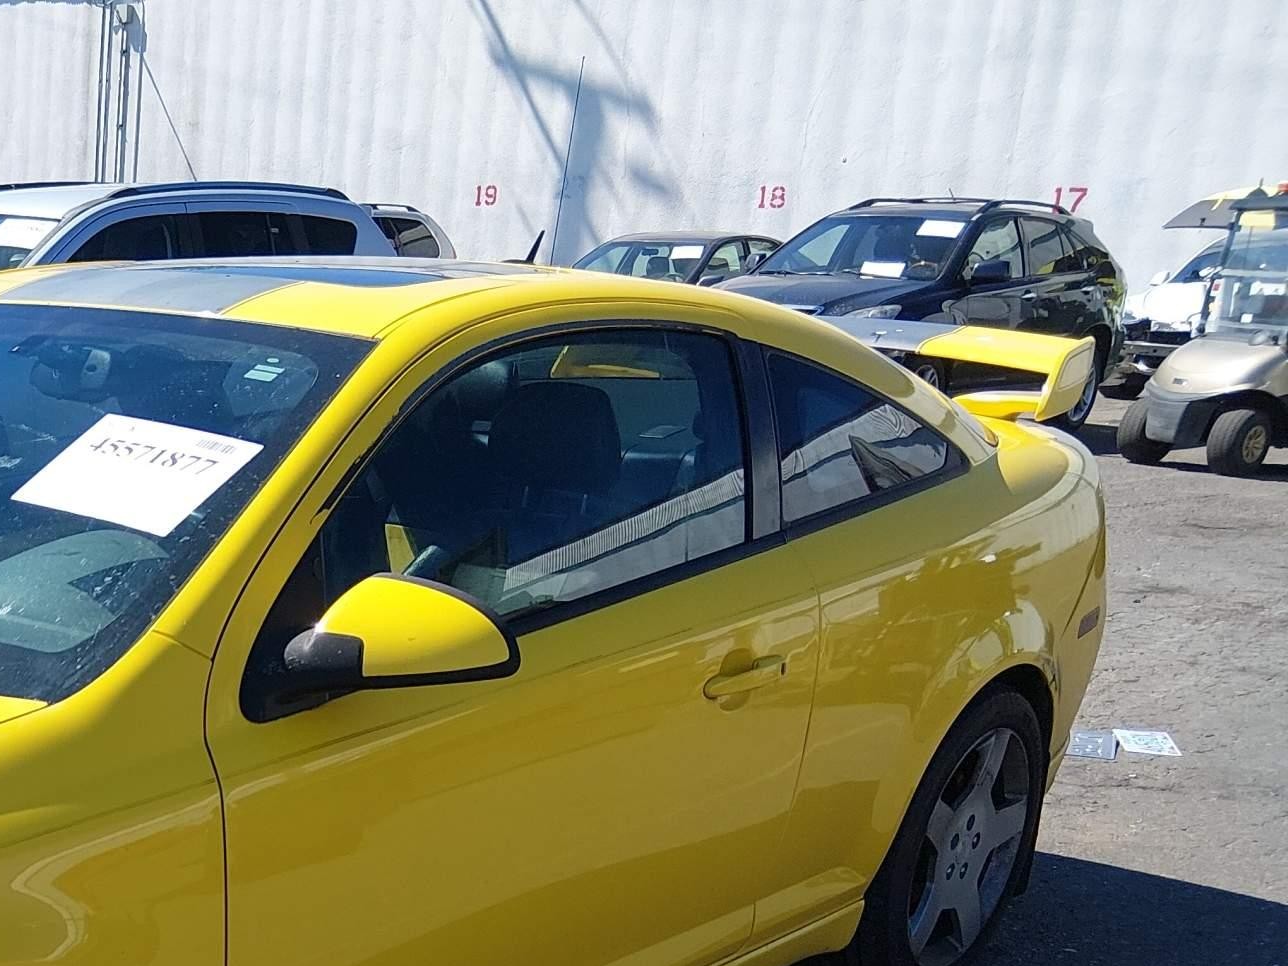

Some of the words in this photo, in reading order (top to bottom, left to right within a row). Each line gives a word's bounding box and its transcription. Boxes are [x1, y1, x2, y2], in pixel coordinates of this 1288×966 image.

[475, 184, 498, 207] 19
[758, 185, 786, 209] 18
[1053, 187, 1088, 214] 17
[90, 437, 220, 475] 45571877
